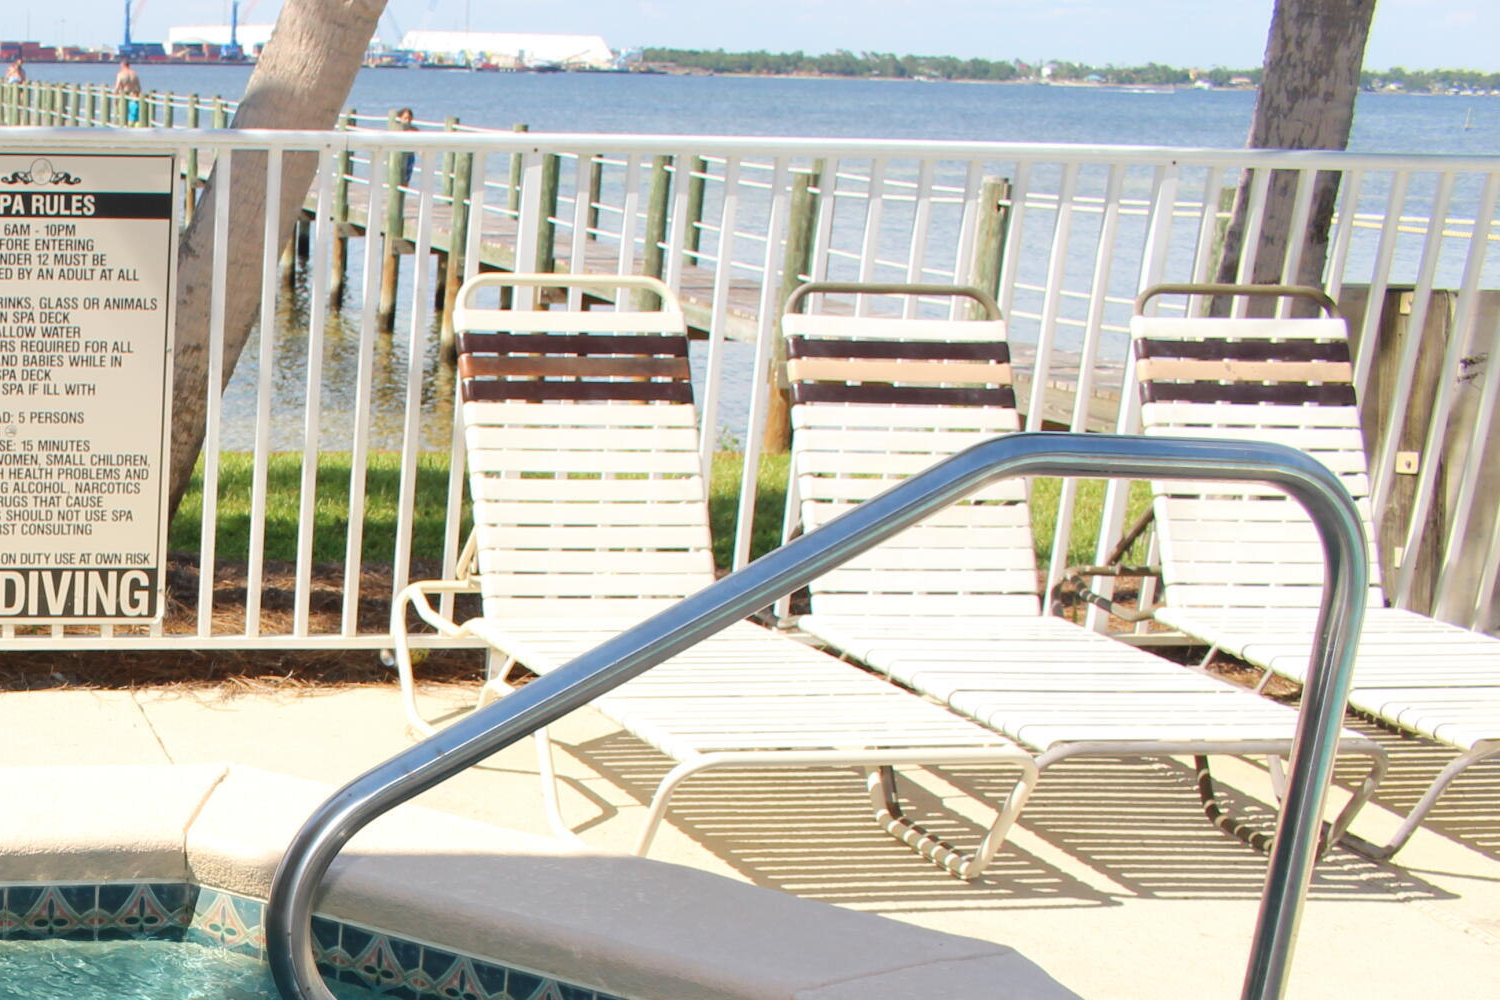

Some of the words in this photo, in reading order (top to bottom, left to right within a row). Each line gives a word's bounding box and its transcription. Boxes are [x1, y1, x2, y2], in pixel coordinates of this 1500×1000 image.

[31, 194, 95, 216] RULES
[3, 224, 31, 236] 6AM
[44, 224, 76, 236] 10PM
[34, 239, 94, 251] ENTERING
[37, 253, 49, 265] 12
[53, 254, 88, 266] MUST
[92, 254, 107, 266] BE
[17, 268, 32, 280] BY
[37, 268, 54, 280] AN
[58, 268, 96, 280] ADULT
[99, 269, 114, 280] AT
[117, 269, 140, 281] ALL
[39, 297, 79, 310] GLASS
[83, 297, 100, 310] OR
[103, 298, 157, 310] ANIMALS
[12, 311, 35, 324] SPA
[39, 312, 70, 324] DECK
[41, 326, 81, 338] WATER
[20, 340, 80, 353] REQUIRED
[84, 341, 108, 353] FOR
[112, 341, 134, 353] ALL
[22, 355, 64, 367] BABIES
[68, 355, 106, 367] WHILE
[110, 356, 122, 367] IN
[21, 369, 52, 381] DECK
[2, 383, 24, 395] SPA
[28, 384, 39, 395] IF
[43, 384, 60, 395] ILL
[64, 384, 96, 395] WITH
[18, 412, 26, 424] 5
[30, 412, 85, 424] PERSONS
[21, 440, 34, 453] 15
[37, 440, 90, 453] MINUTES
[46, 454, 86, 467] SMALL
[90, 454, 151, 468] CHILDREN,
[8, 468, 53, 479] HEALTH
[57, 468, 121, 480] PROBLEMS
[124, 467, 149, 480] AND
[13, 482, 70, 494] ALCOHOL,
[74, 482, 141, 494] NARCOTICS
[32, 496, 62, 507] THAT
[65, 495, 104, 508] CAUSE
[5, 510, 53, 523] SHOULD
[57, 510, 81, 521] NOT
[84, 510, 107, 521] USE
[111, 510, 134, 521] SPA
[20, 523, 92, 535] CONSULTING
[0, 553, 16, 564] ON
[20, 553, 51, 564] DUTY
[54, 553, 76, 564] USE
[79, 553, 92, 564] AT
[95, 553, 122, 564] OWN
[125, 553, 150, 565] RISK
